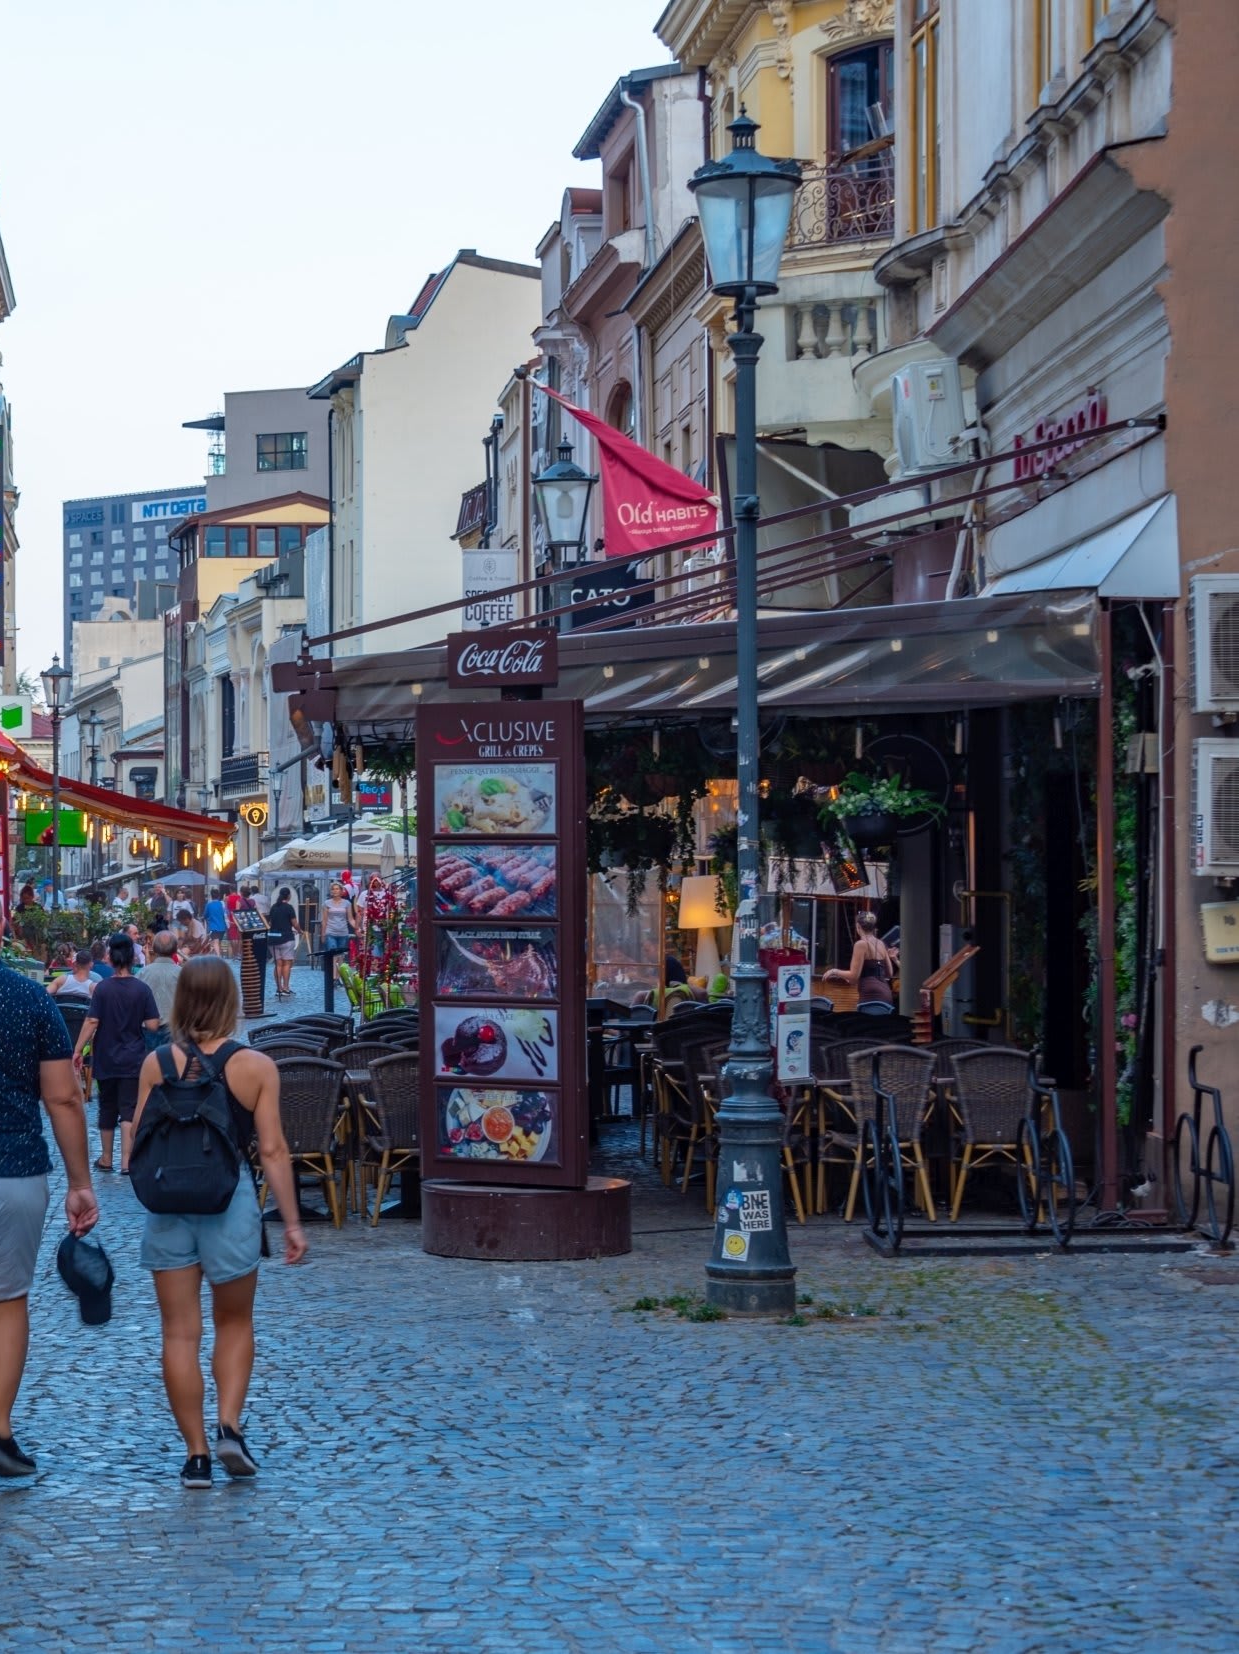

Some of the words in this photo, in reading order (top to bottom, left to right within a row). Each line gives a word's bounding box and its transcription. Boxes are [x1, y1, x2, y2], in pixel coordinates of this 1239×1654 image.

[72, 511, 104, 521] SPACES
[143, 502, 169, 518] NTT
[618, 500, 654, 525] Old
[655, 505, 709, 522] HABITS
[465, 604, 513, 621] COFFEE
[457, 640, 546, 676] Coca-Cola
[479, 746, 502, 758] GRILL
[513, 745, 543, 757] CREPES
[309, 851, 330, 859] pepsi
[742, 1193, 769, 1210] BNE
[743, 1210, 769, 1220] WAS
[743, 1220, 770, 1230] HERE
